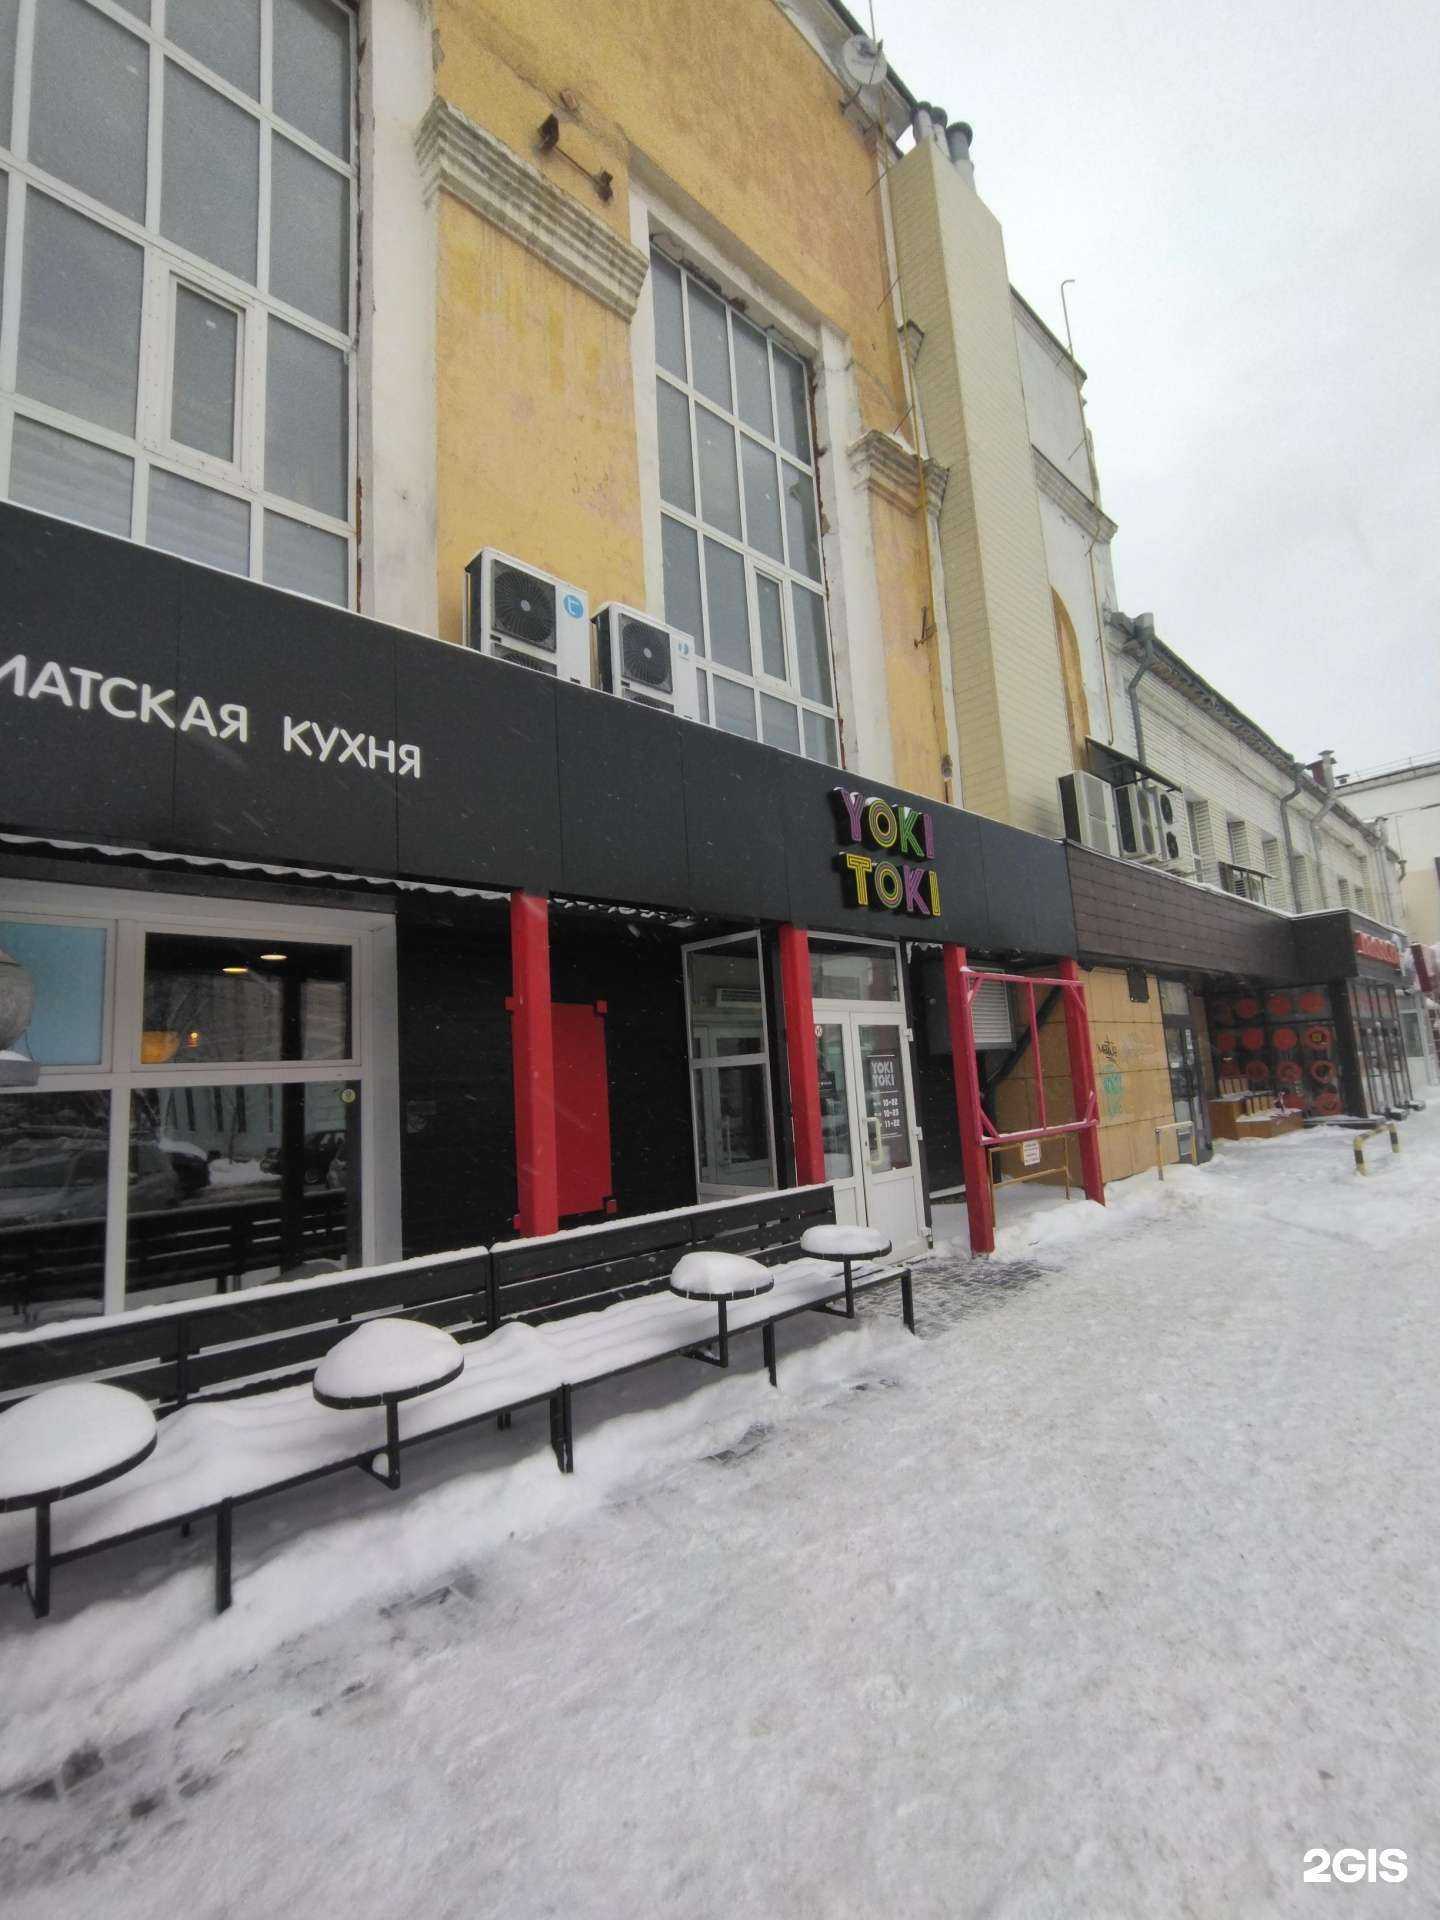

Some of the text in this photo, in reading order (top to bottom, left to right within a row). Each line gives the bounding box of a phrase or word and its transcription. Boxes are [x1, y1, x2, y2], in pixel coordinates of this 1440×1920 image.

[283, 715, 421, 779] КУХНЯ
[839, 787, 936, 860] YOKI
[845, 852, 942, 917] TOKI
[871, 1061, 894, 1074] YOKI
